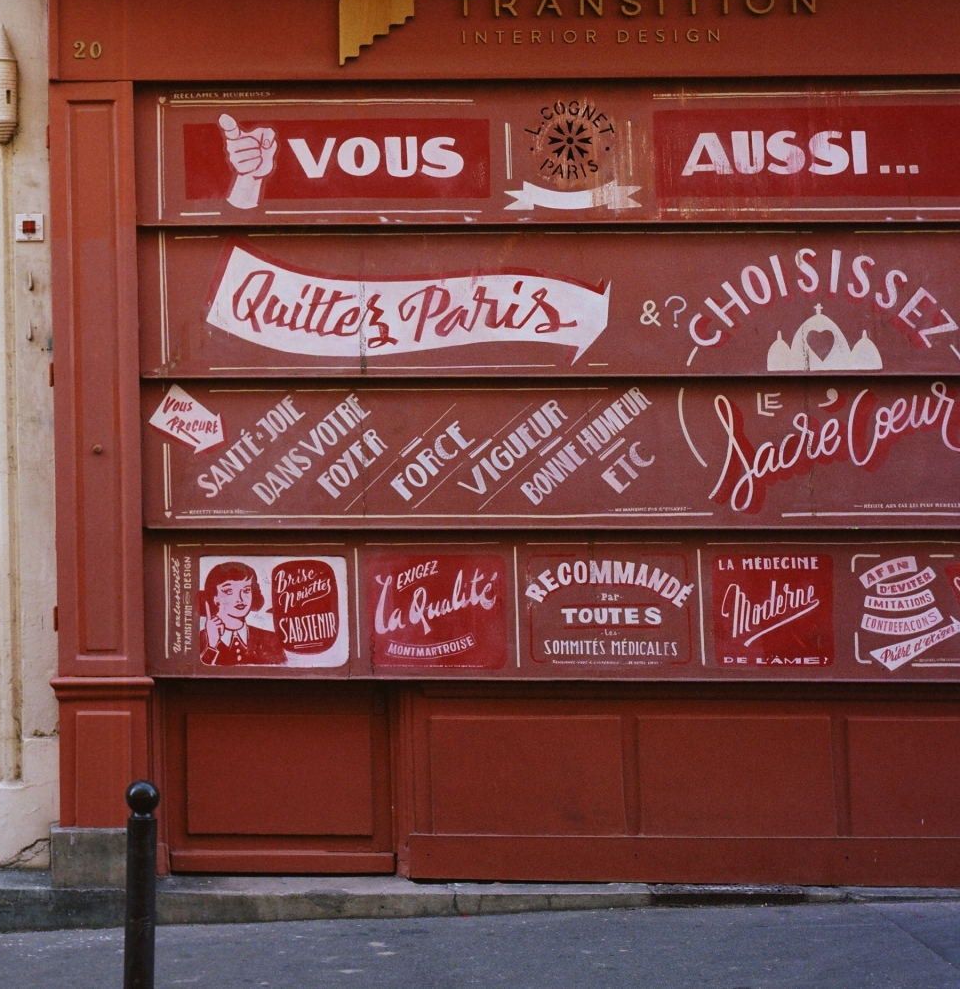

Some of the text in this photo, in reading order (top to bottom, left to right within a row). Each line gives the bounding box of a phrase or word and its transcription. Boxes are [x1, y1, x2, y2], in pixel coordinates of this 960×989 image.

[73, 40, 102, 60] 20
[460, 28, 722, 44] INTERIOR DESIGN
[288, 136, 464, 180] VOUS
[540, 157, 600, 180] PARIS
[398, 280, 578, 343] Paris
[688, 247, 960, 348] CHOISISSEZ
[756, 392, 784, 417] LE
[196, 428, 264, 498] SANTÉ
[256, 394, 306, 443] JOIE
[251, 392, 372, 506] DANS VOTRE
[390, 420, 476, 502] FORCE
[456, 398, 569, 496] VIGUEUR
[519, 386, 652, 506] BONNE HUMEUR
[316, 428, 388, 500] FOYER
[600, 441, 656, 494] ETC
[183, 556, 192, 590] DESIGN
[396, 560, 438, 590] EXIGEZ
[718, 556, 819, 570] LA MÉDECINE
[866, 560, 909, 585] AFIN
[525, 560, 695, 608] RECOMMANDÉ
[880, 572, 932, 594] D'ÉVITER
[408, 568, 498, 636] Qualité
[561, 607, 662, 625] TOUTES
[722, 580, 820, 638] Moderne
[868, 593, 932, 609] IMITATIONS
[184, 604, 193, 654] TRANSITION
[278, 612, 337, 644] S'ABSTENIR
[866, 612, 938, 633] CONTREFAÇONS
[387, 636, 475, 658] MONTMARTROISE
[544, 638, 678, 656] SOMMITÉS MÉDICALES
